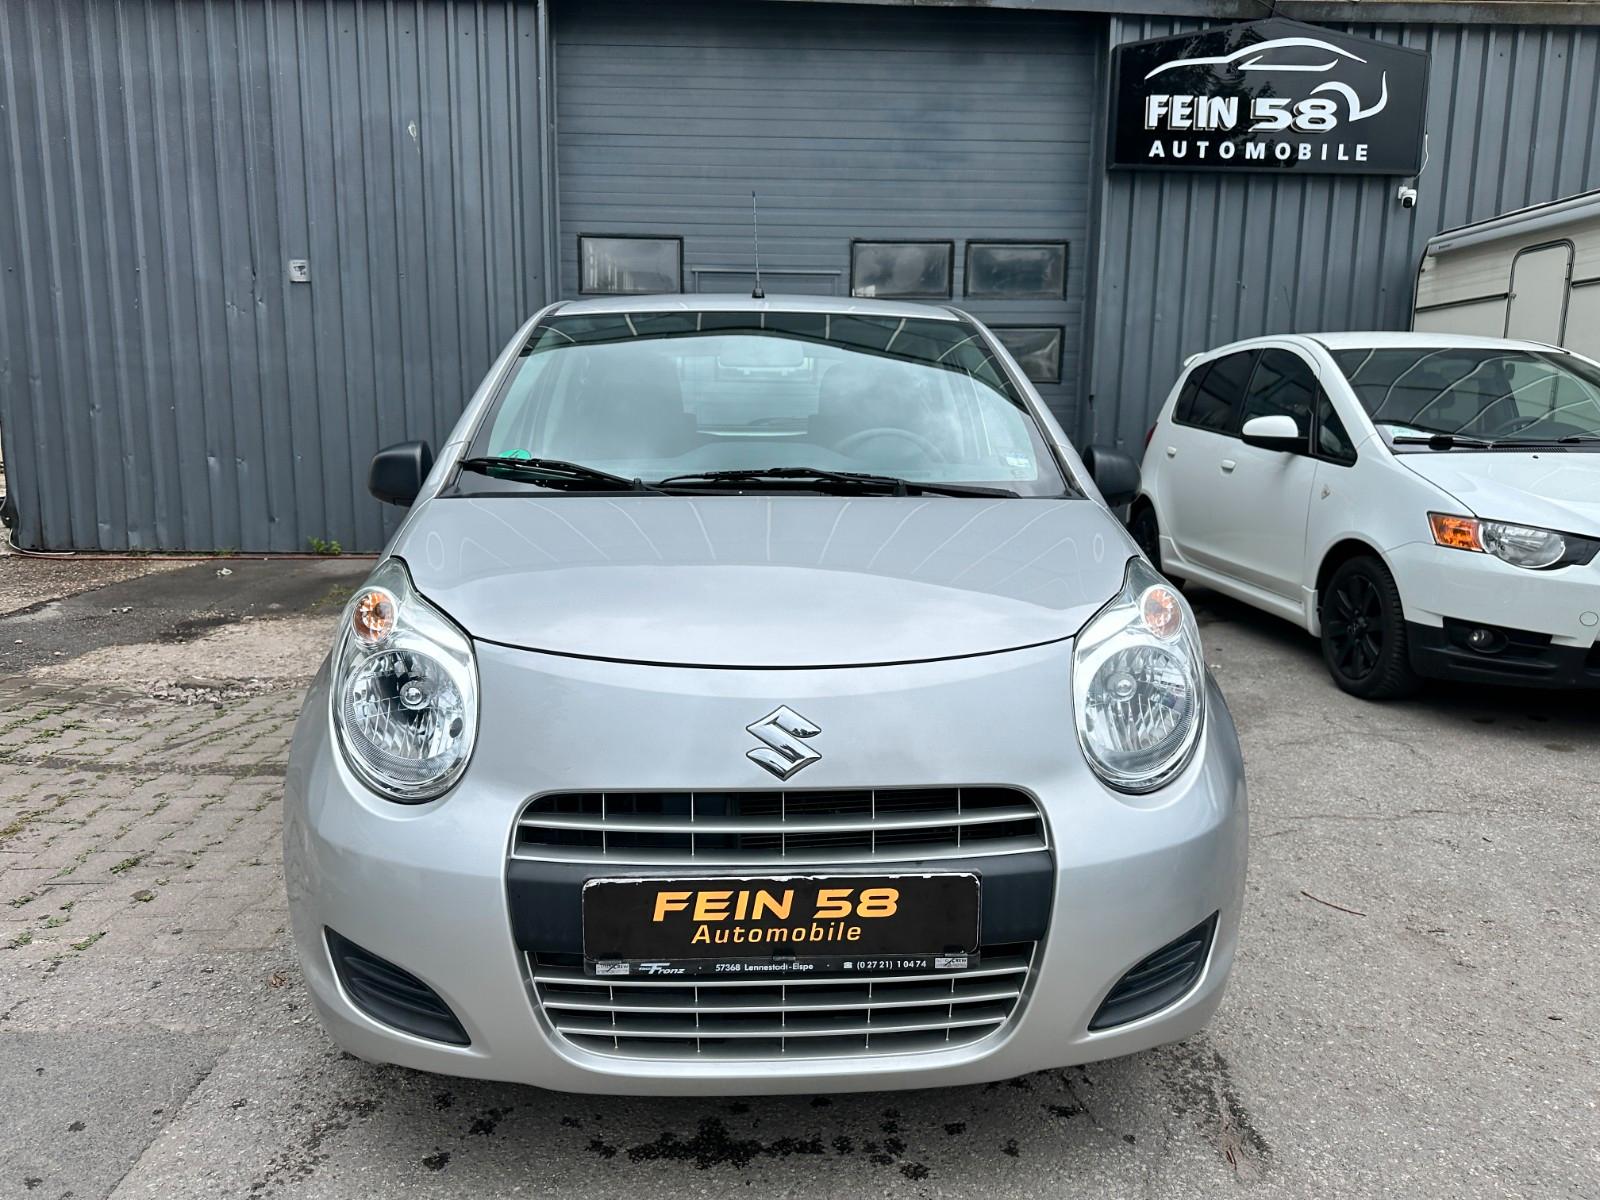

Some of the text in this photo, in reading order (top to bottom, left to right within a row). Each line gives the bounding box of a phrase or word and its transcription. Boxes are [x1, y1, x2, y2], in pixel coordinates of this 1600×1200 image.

[1145, 94, 1338, 133] FEIN 58
[1148, 140, 1369, 162] AUTOMOBILE
[652, 887, 900, 922] FEIN 58
[690, 921, 862, 944] Automobile
[715, 963, 741, 972] 57368
